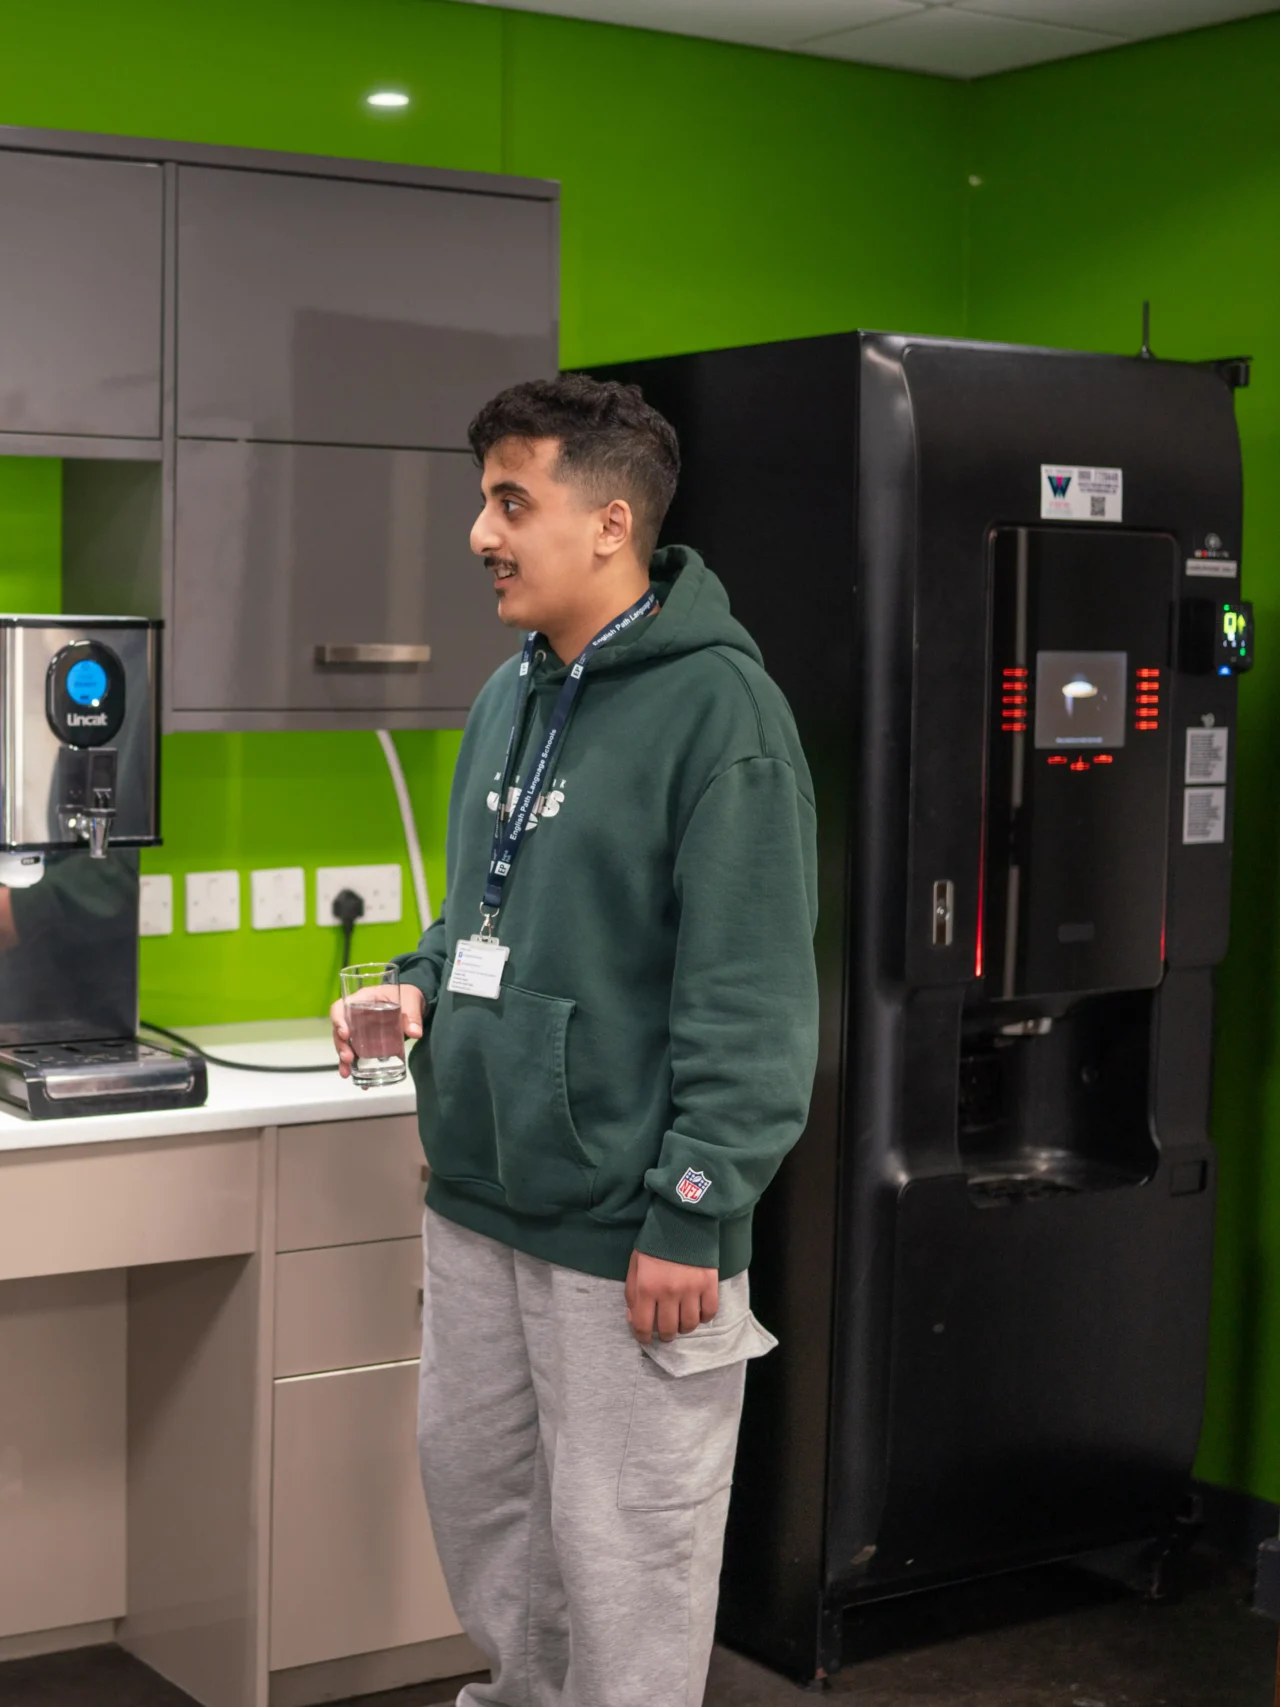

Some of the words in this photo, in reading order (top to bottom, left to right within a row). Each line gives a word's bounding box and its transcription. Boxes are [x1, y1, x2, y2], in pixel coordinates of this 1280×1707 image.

[592, 628, 617, 646] English
[615, 617, 631, 631] Path
[66, 712, 108, 726] Lincat
[510, 812, 525, 840] English
[520, 796, 532, 813] Path
[527, 759, 546, 795] Language
[541, 728, 557, 758] Schools
[680, 1179, 700, 1200] NFL
